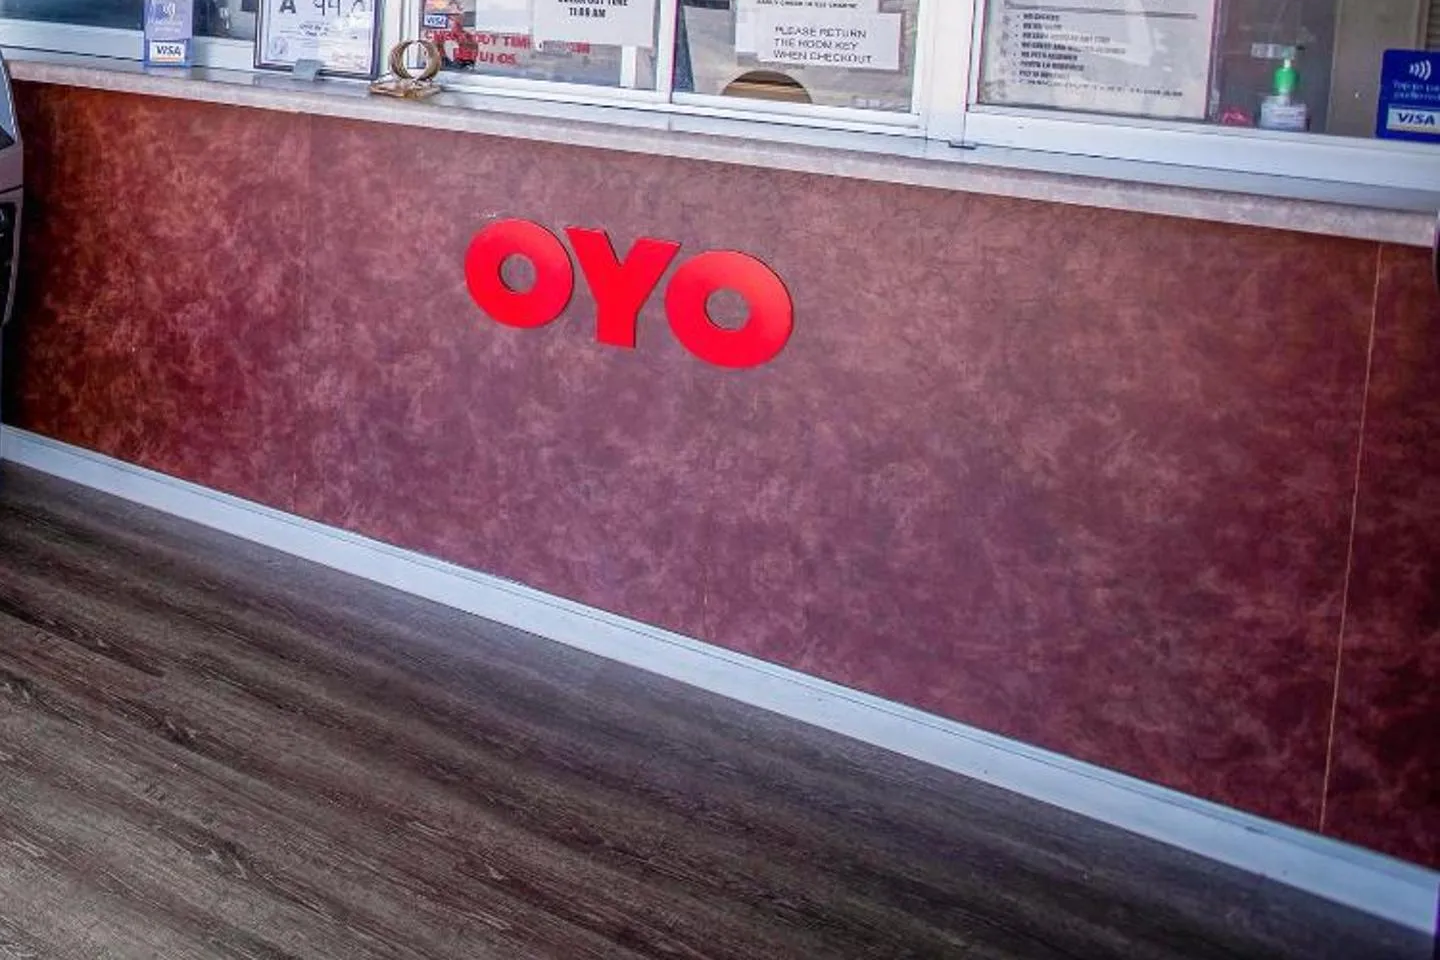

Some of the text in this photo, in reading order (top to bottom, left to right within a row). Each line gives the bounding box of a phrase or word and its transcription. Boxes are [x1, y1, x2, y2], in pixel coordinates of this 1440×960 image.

[775, 26, 867, 39] PLEASE RETURN
[774, 38, 796, 47] THE
[835, 41, 859, 50] KEY
[773, 49, 807, 60] WHEN
[1398, 112, 1435, 126] VISA
[464, 218, 795, 369] OYO
